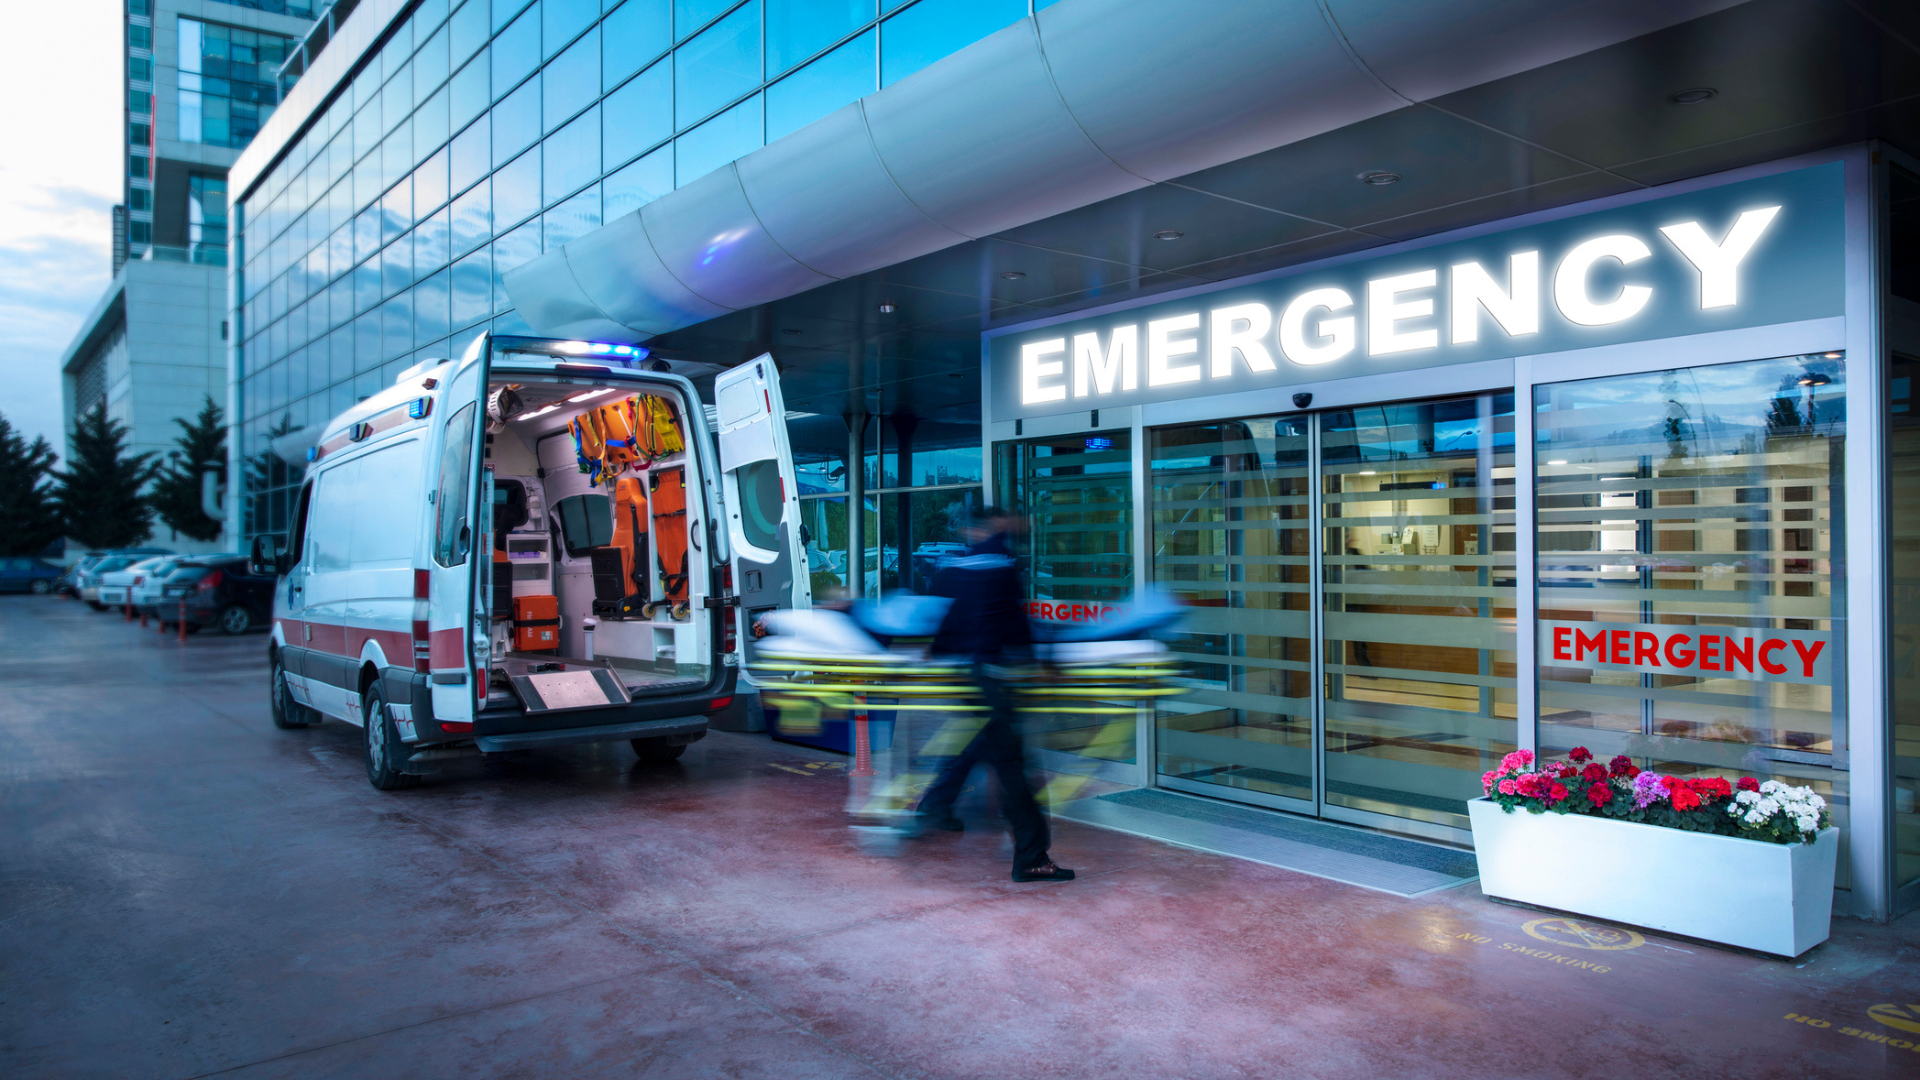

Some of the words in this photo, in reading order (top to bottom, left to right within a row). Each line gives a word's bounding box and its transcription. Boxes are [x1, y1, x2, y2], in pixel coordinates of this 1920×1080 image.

[1021, 205, 1782, 406] EMERGENCY
[1020, 602, 1132, 623] MERGENCY
[1553, 626, 1827, 678] EMERGENCY
[1456, 932, 1493, 944] NO
[1498, 942, 1612, 974] SMOKING
[1783, 1012, 1832, 1029] NO
